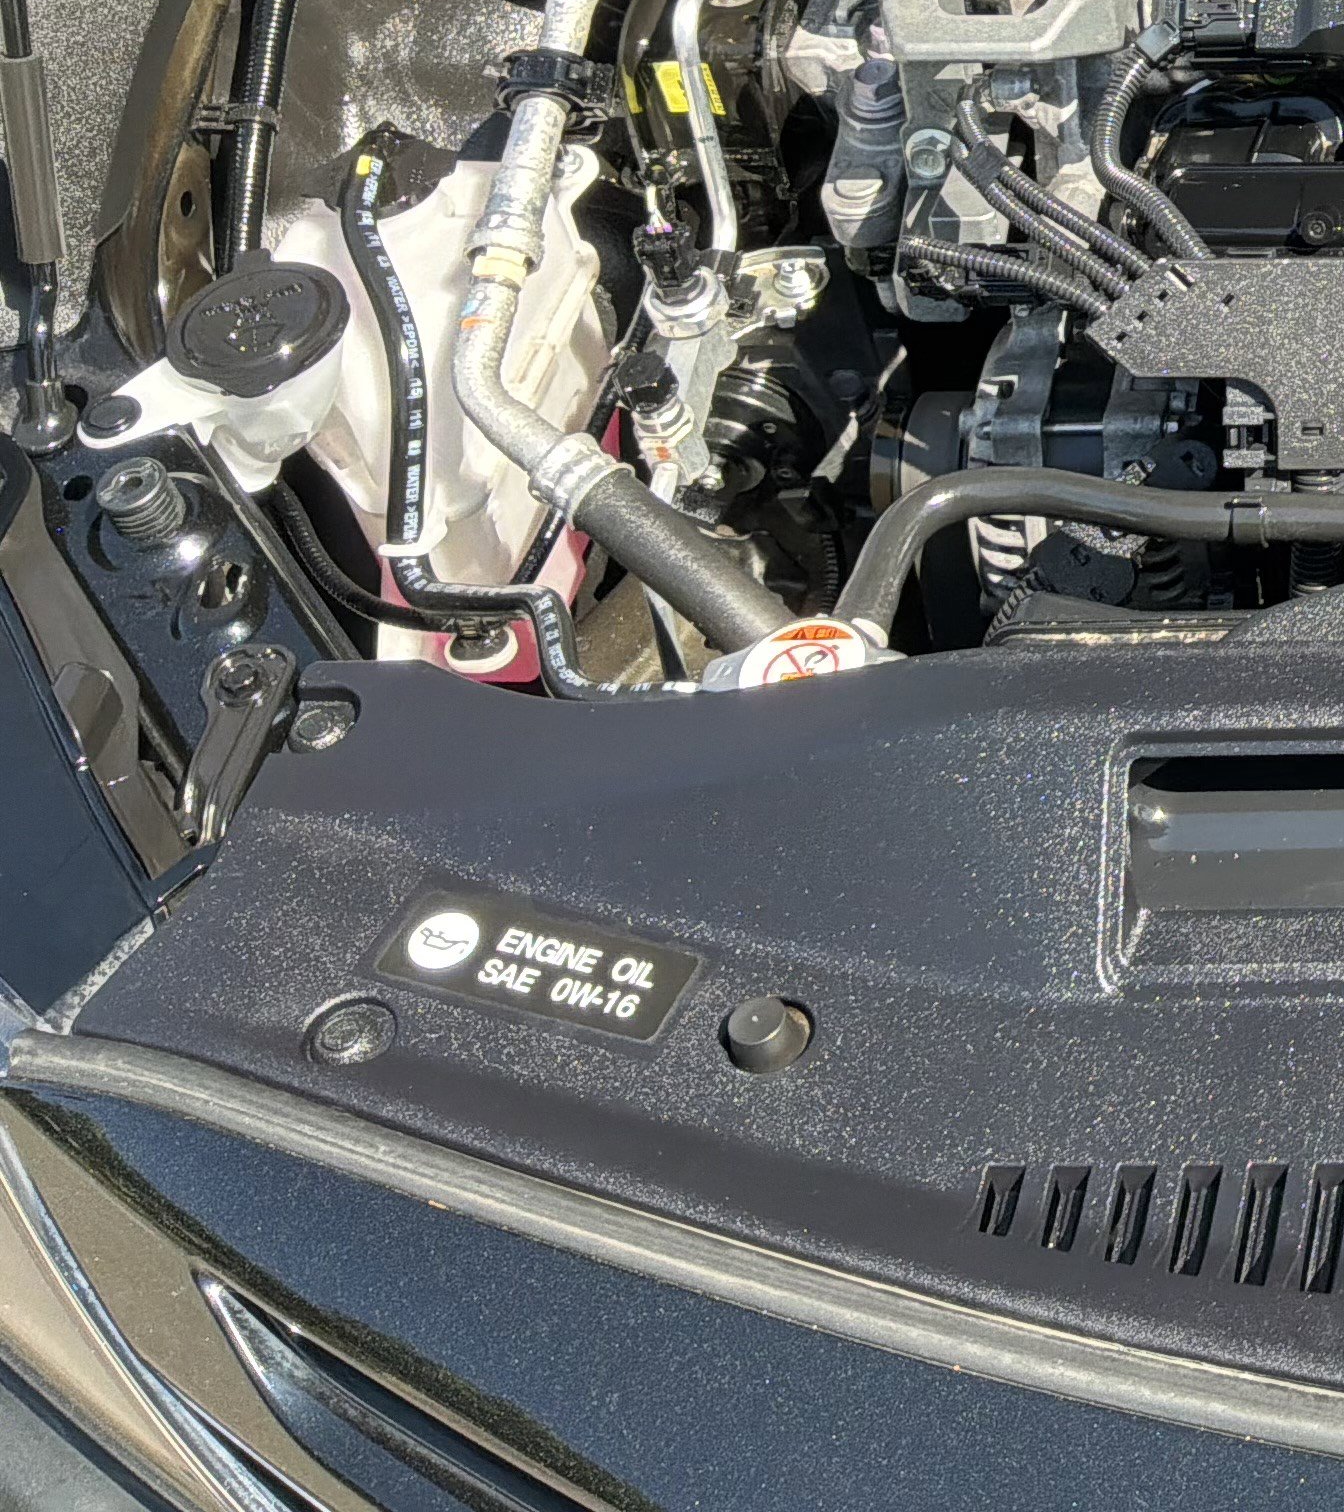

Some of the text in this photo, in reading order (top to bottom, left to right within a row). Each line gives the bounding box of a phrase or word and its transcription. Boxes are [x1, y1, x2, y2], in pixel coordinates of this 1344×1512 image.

[385, 274, 410, 314] WATER
[477, 958, 641, 1019] SAE 0W-16
[495, 928, 655, 989] ENGINE OIL
